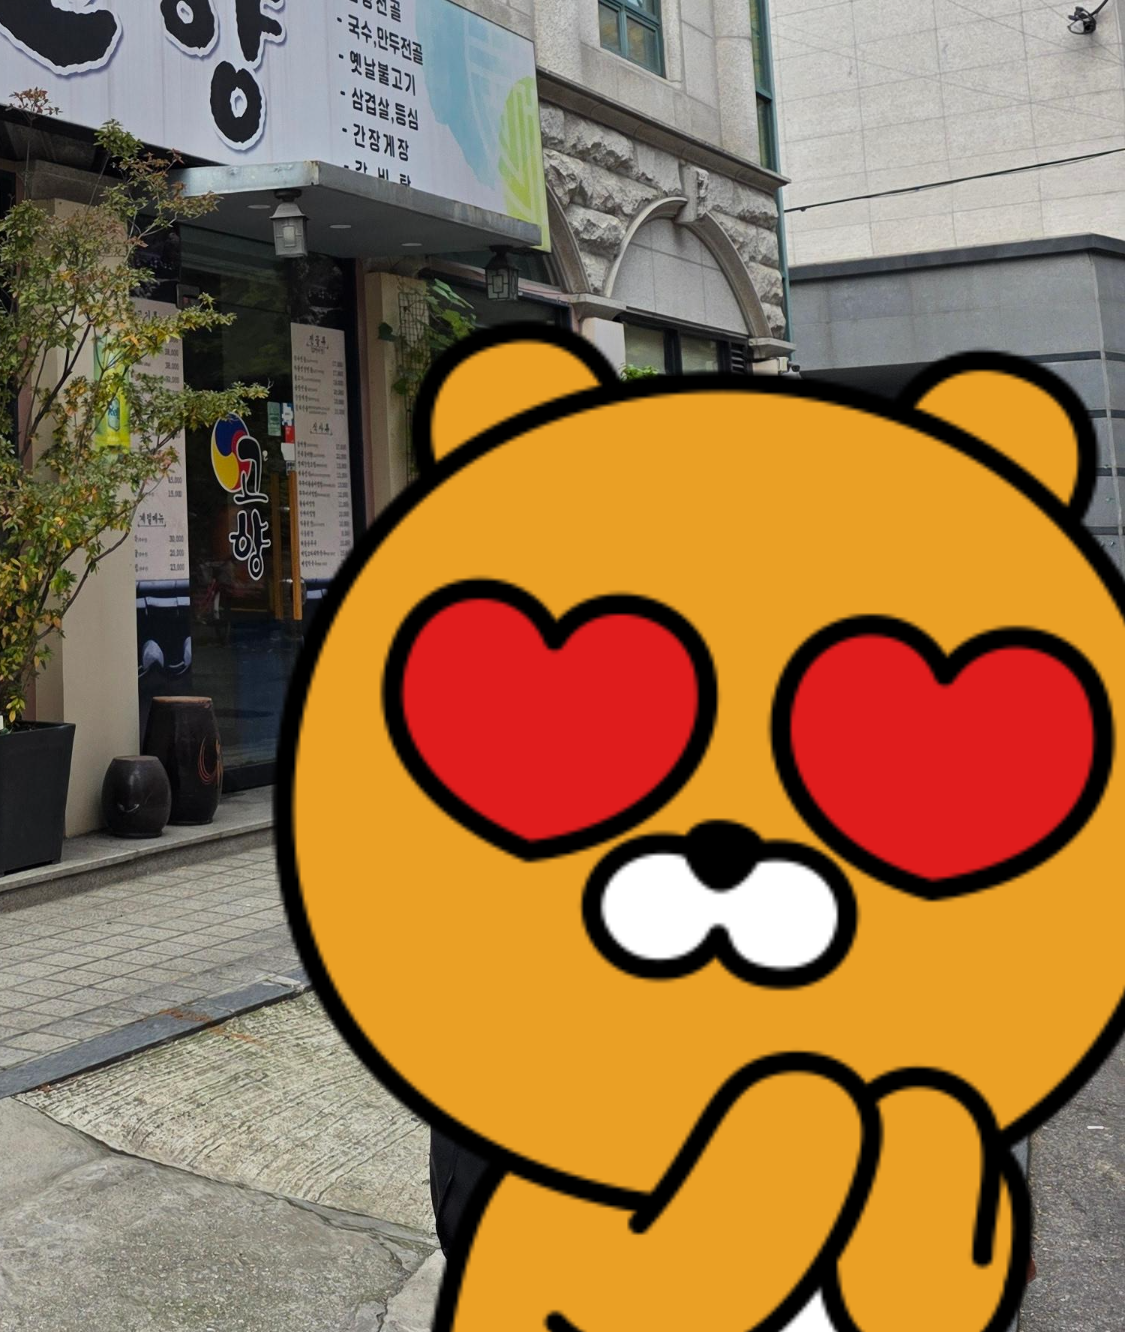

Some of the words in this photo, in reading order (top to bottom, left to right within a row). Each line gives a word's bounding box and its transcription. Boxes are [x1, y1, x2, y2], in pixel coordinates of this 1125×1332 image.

[347, 13, 425, 67] 국수,만두전골
[348, 49, 417, 97] 옛날불고기
[350, 86, 420, 132] 삼겹살,등심
[352, 122, 410, 163] 간장게장
[229, 435, 272, 582] 고향
